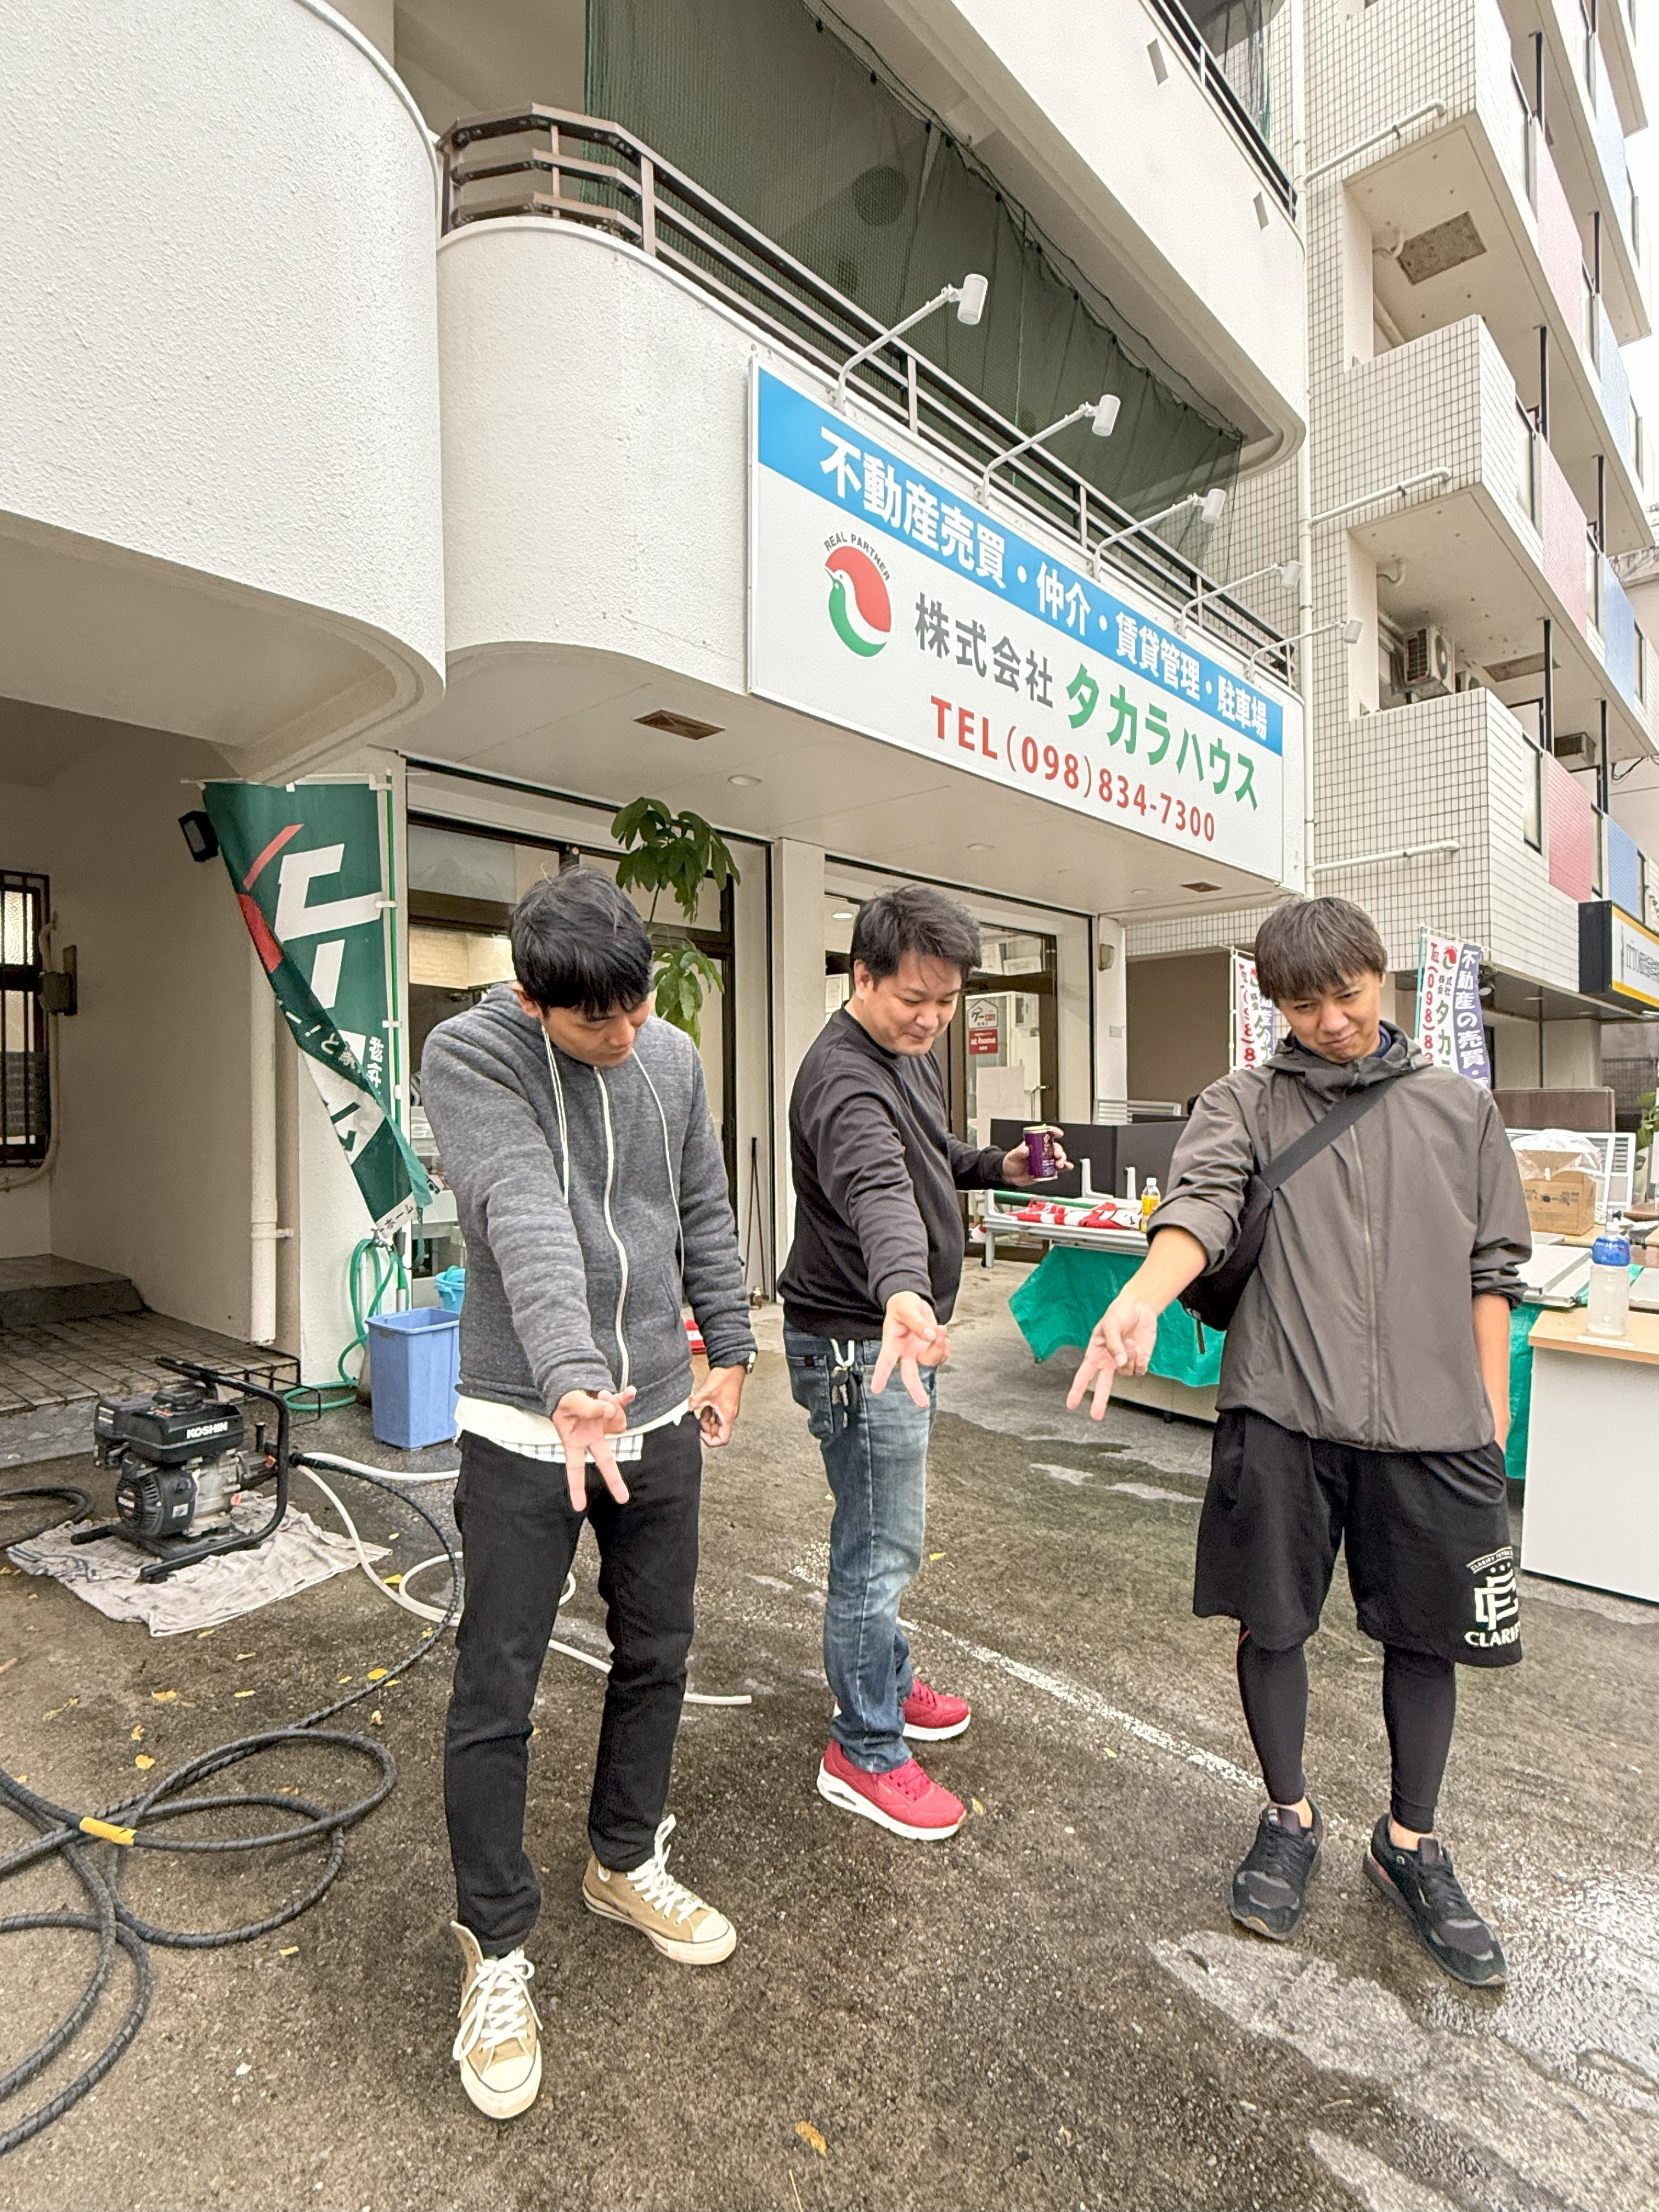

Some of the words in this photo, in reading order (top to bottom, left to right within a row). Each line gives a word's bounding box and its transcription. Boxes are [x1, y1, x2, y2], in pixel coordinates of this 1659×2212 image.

[824, 532, 848, 552] REAL
[851, 533, 890, 581] PARTNER
[915, 592, 1053, 709] 株式会社
[1065, 663, 1258, 811] タカラハウス
[187, 1421, 228, 1439] KOSHIN
